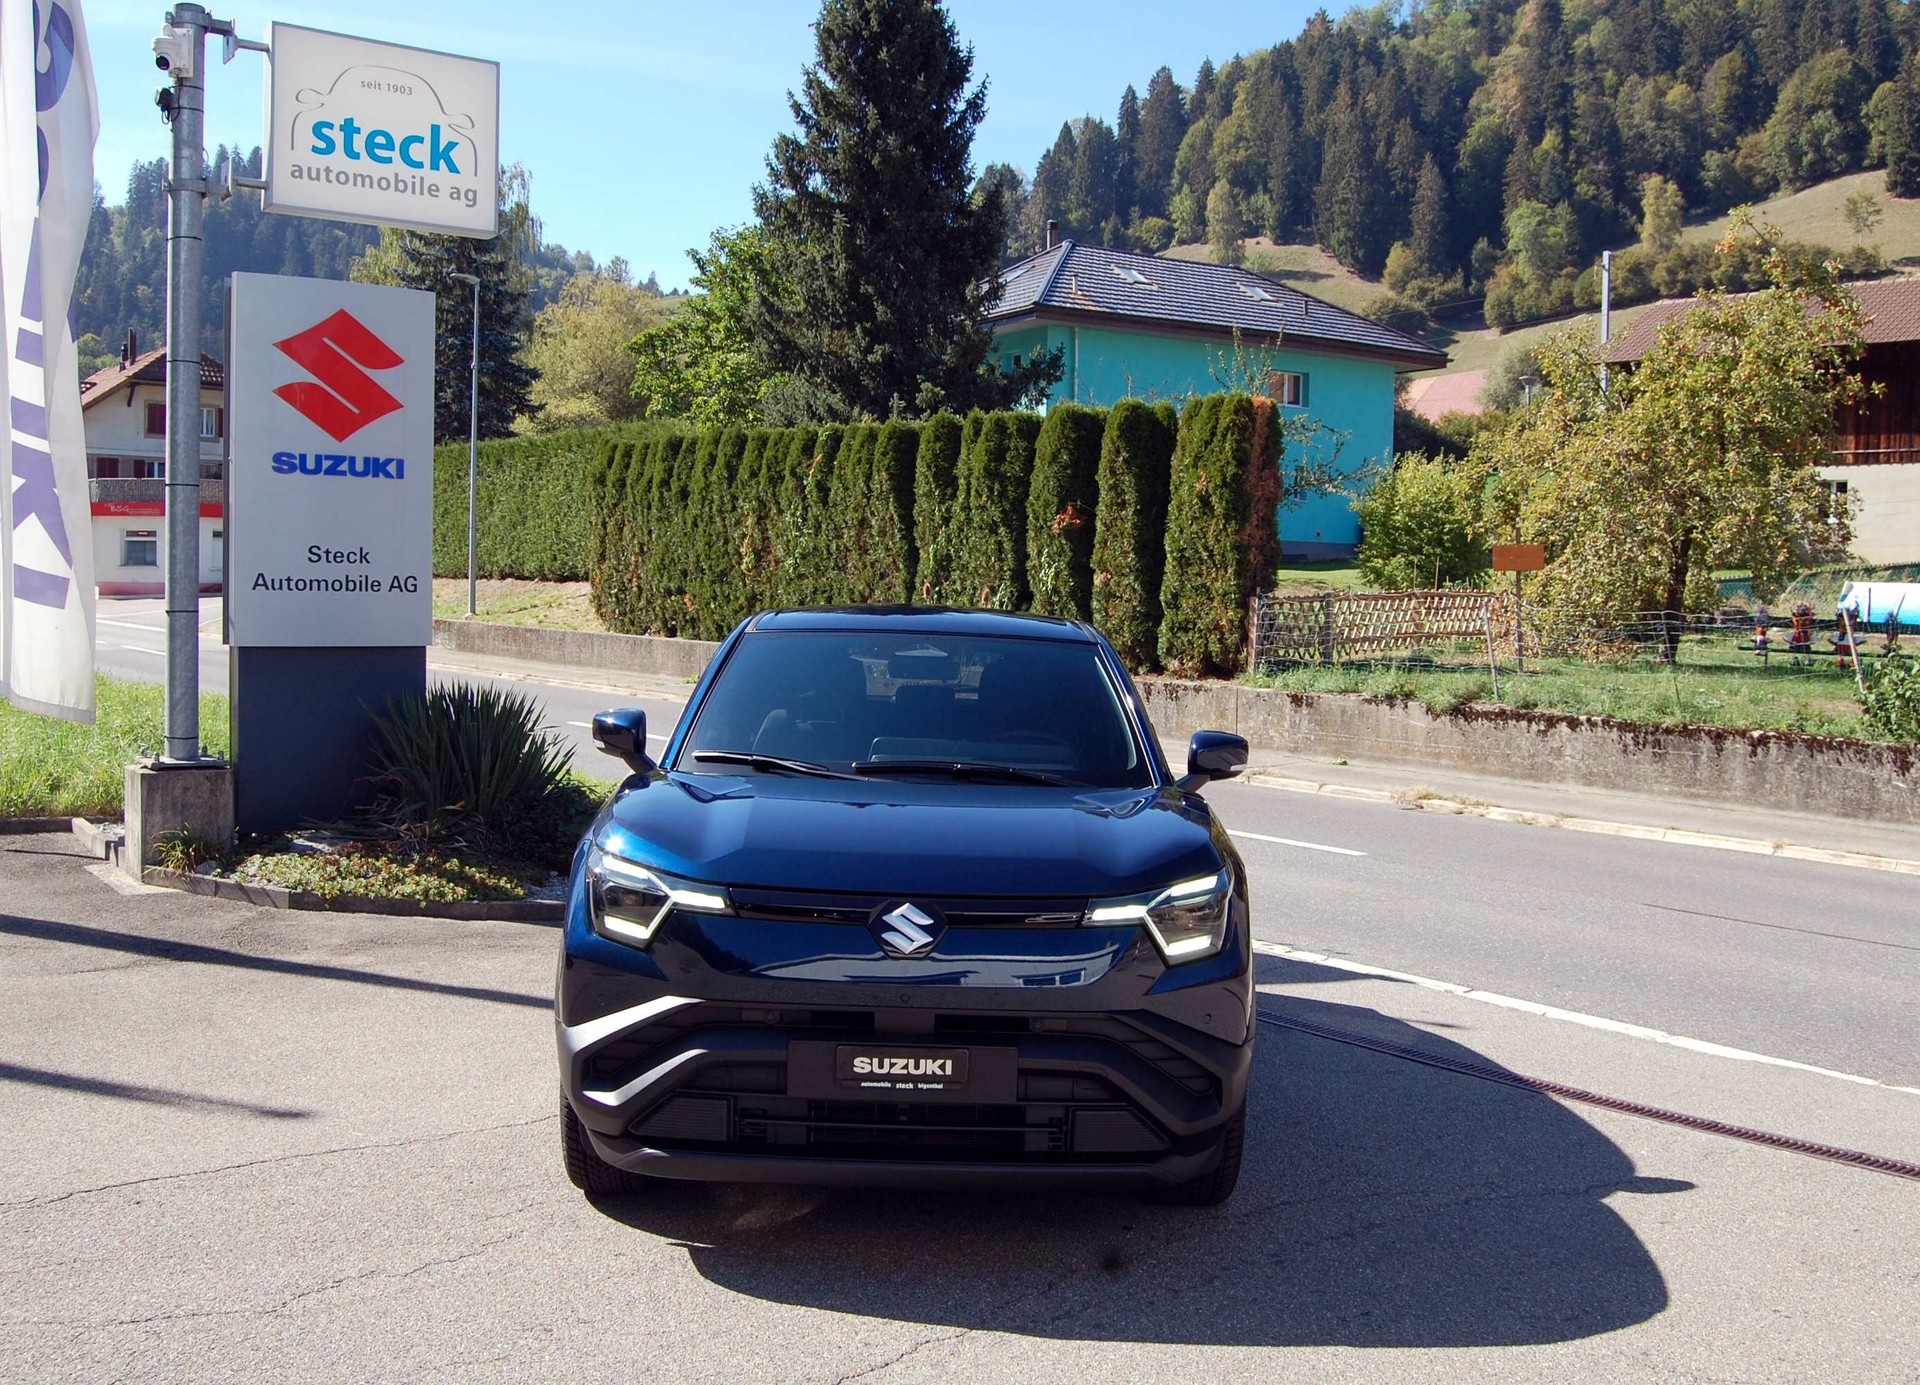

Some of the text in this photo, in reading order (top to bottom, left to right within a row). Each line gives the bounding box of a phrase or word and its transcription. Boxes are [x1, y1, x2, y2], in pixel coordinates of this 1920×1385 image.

[360, 79, 414, 96] seit 1903
[311, 117, 461, 175] steck
[290, 163, 478, 208] automobile ag
[271, 451, 405, 480] SUZUKI
[307, 545, 371, 565] Steck
[252, 572, 418, 593] Automobile AG
[853, 1056, 953, 1076] SUZUKI
[895, 1082, 914, 1090] steck
